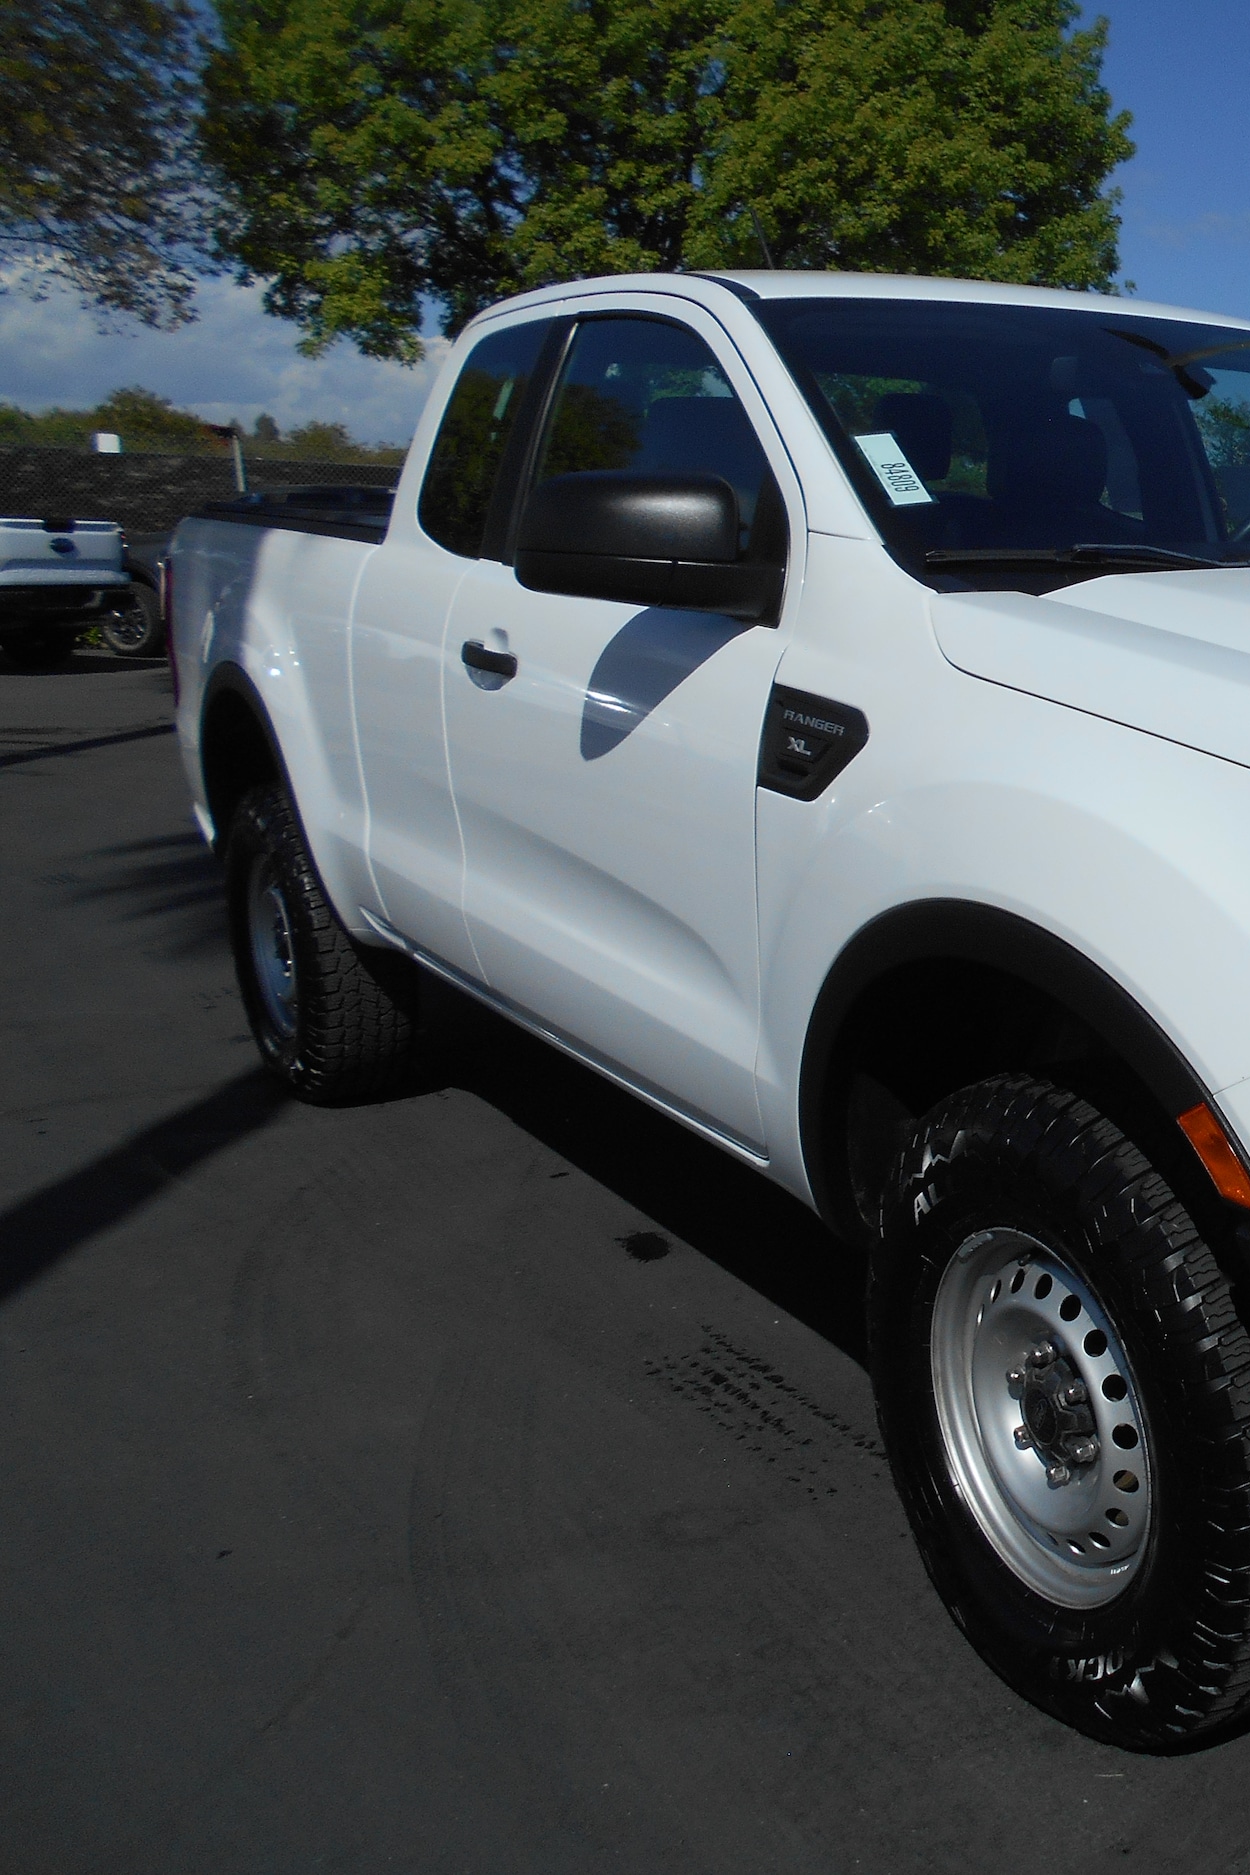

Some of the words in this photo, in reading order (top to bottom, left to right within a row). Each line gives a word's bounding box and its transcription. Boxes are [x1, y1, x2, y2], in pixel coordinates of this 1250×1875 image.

[881, 462, 920, 493] 84809
[783, 709, 845, 736] RANGER
[787, 736, 811, 756] XL
